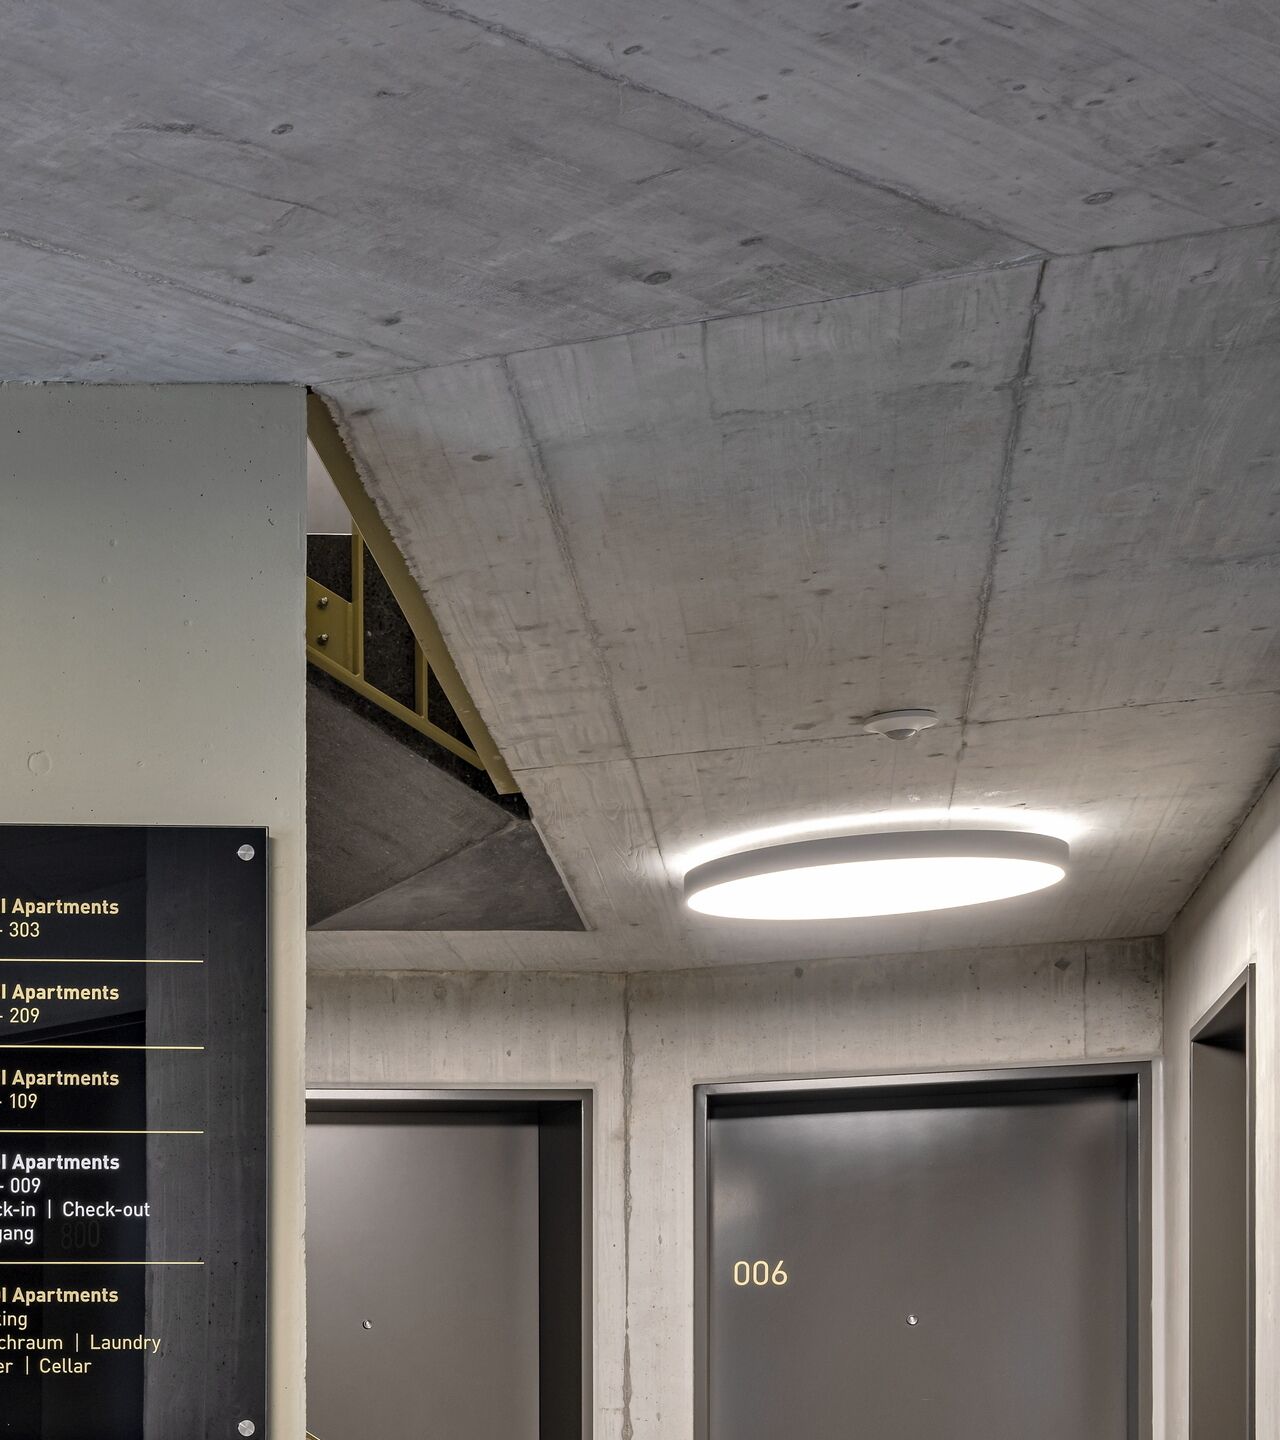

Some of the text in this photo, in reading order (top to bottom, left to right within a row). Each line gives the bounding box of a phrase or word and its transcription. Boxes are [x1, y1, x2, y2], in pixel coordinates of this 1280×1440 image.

[11, 898, 119, 918] Apartments
[9, 921, 40, 938] 303
[11, 983, 120, 1004] Apartments
[9, 1007, 40, 1024] 209
[11, 1069, 120, 1089] Apartments
[9, 1093, 38, 1109] 109
[11, 1153, 120, 1174] Apartments
[10, 1177, 41, 1194] 009
[62, 1201, 151, 1217] Check-out
[733, 1260, 788, 1286] 006
[11, 1286, 119, 1307] Apartments
[90, 1334, 162, 1354] Laundry
[39, 1357, 92, 1374] Cellar
